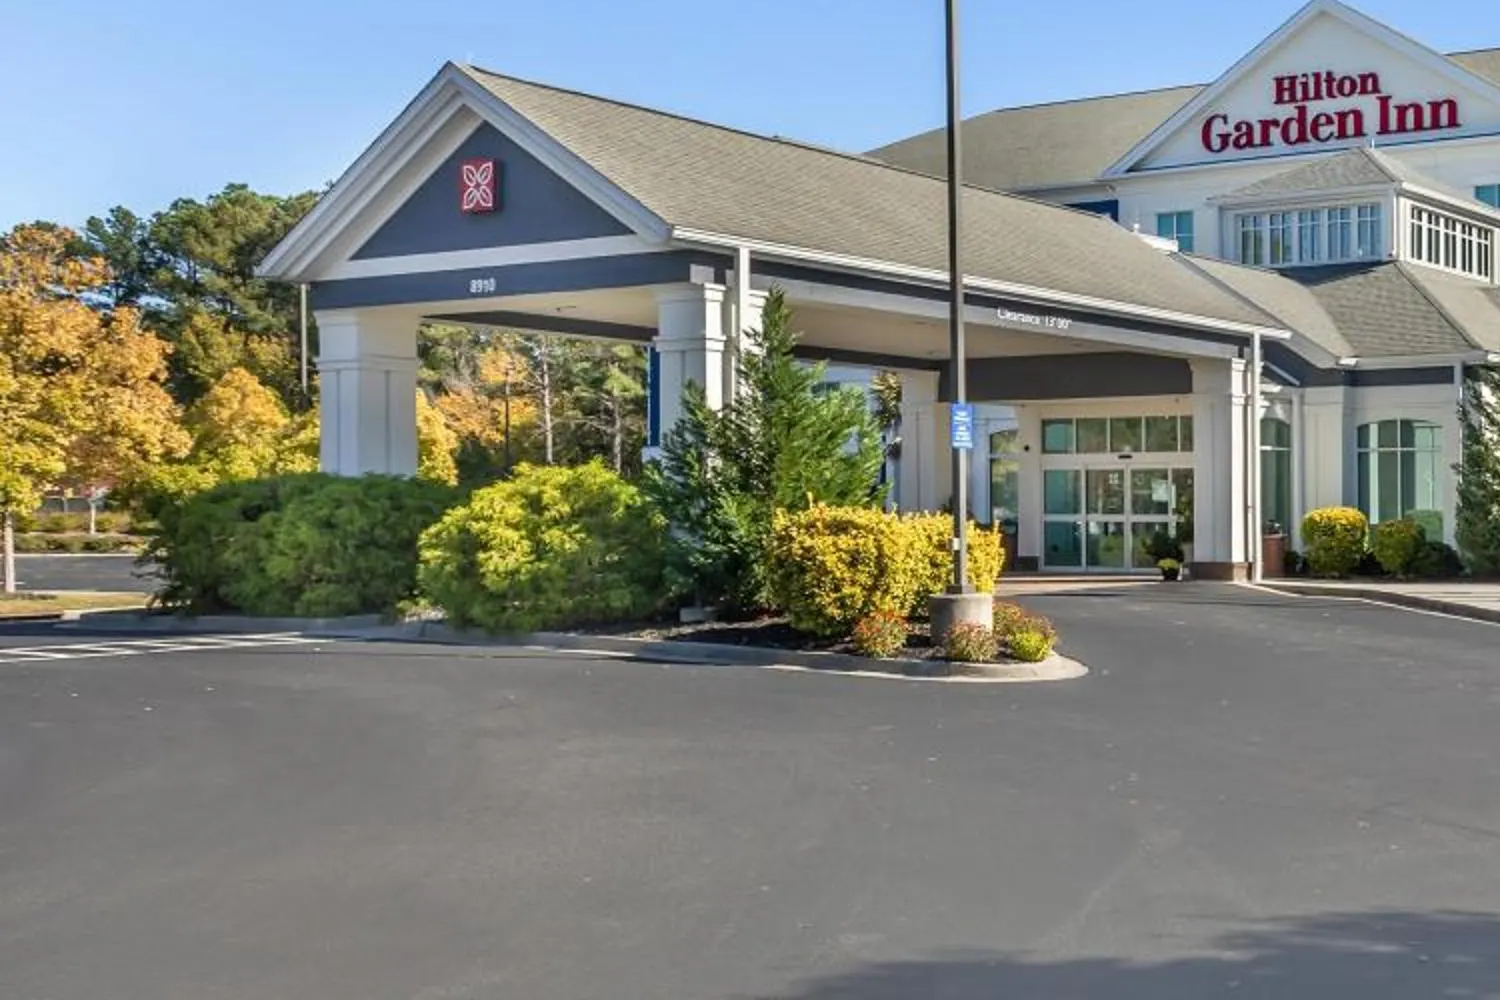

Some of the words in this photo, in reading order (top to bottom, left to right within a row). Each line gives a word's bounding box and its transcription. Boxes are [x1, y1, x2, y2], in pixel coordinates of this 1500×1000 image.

[1273, 71, 1381, 105] Hilton
[1202, 105, 1367, 153] Garden
[1376, 95, 1461, 135] Inn
